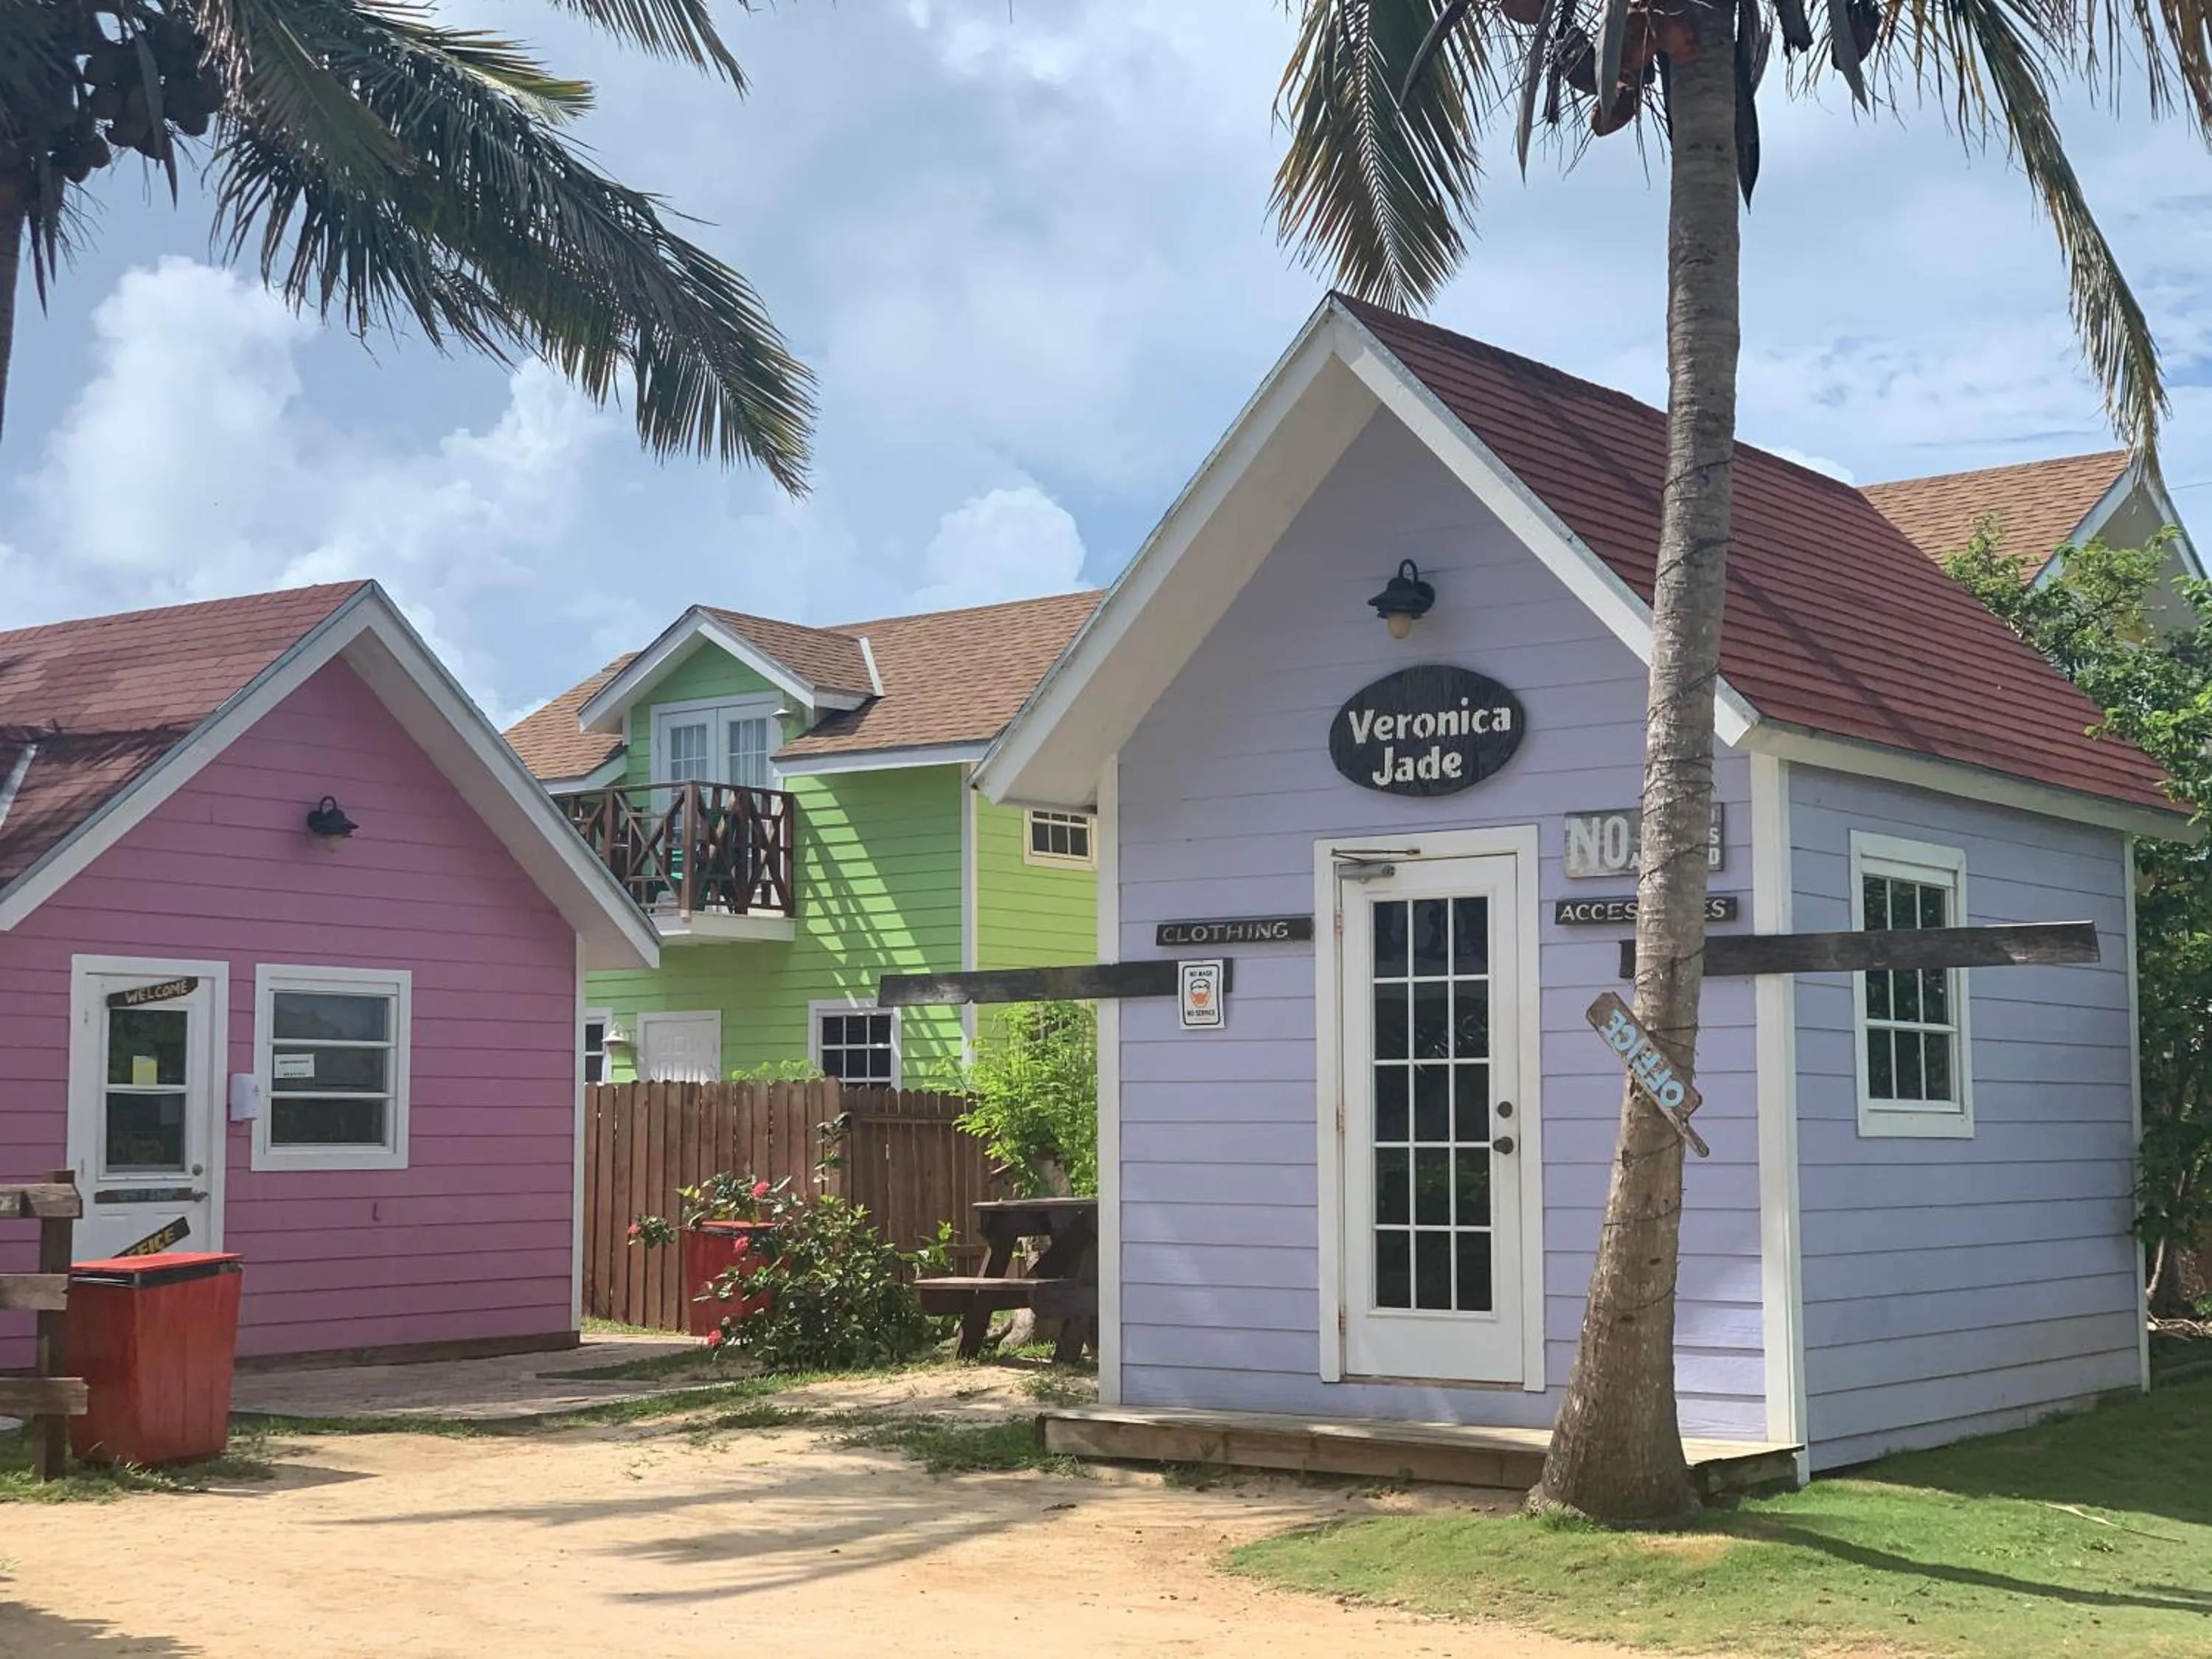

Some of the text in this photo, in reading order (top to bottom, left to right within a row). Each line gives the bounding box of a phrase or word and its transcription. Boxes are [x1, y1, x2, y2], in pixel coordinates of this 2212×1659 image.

[1349, 697, 1512, 744] Veronica
[1372, 746, 1463, 786] Jade
[1568, 816, 1629, 871] NO
[1559, 899, 1726, 921] ACCESS
[1162, 921, 1289, 942] CLOTHING
[124, 979, 188, 1004] WELCOME
[1599, 1009, 1686, 1107] OFFICE
[127, 1226, 175, 1256] FICE
